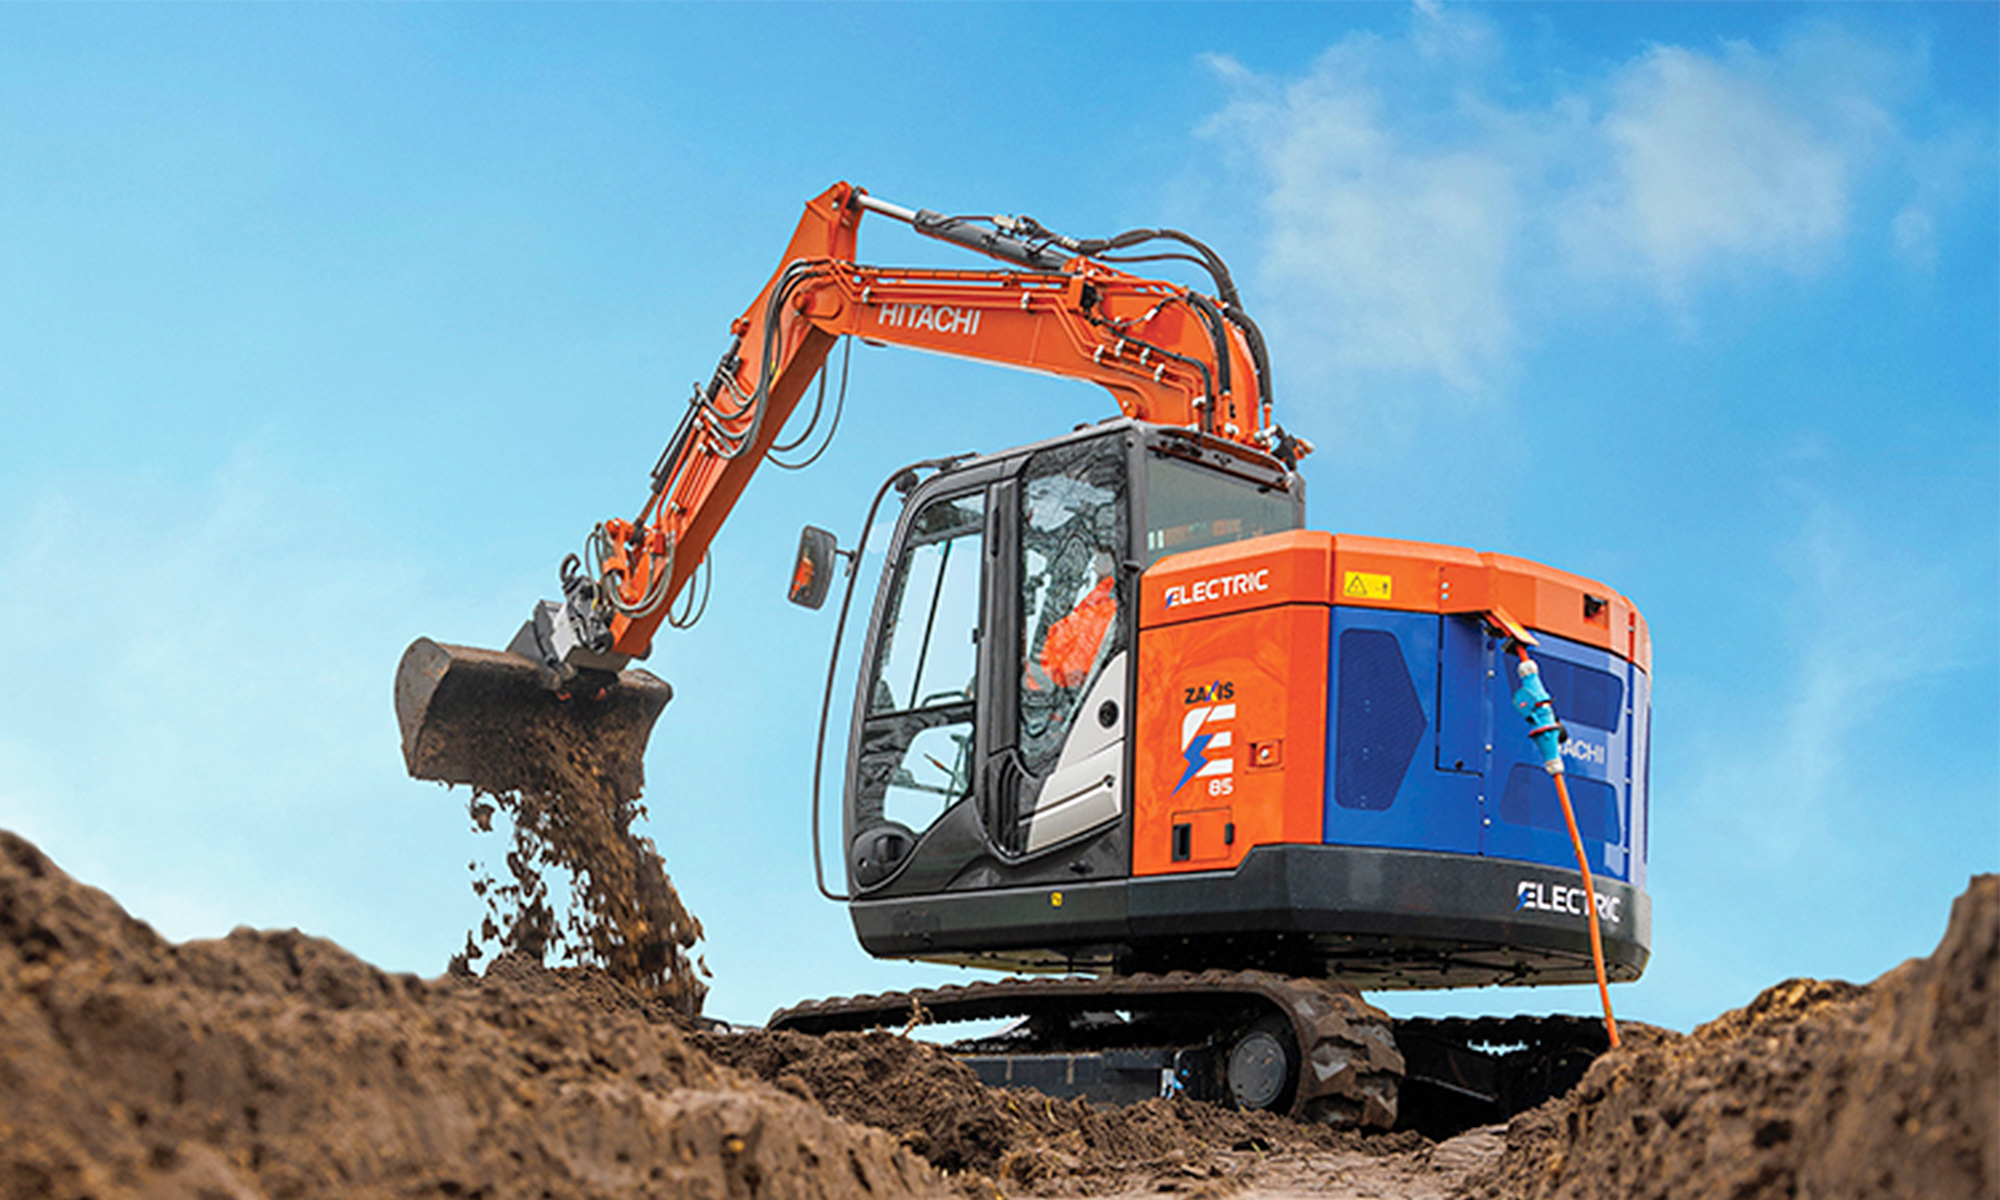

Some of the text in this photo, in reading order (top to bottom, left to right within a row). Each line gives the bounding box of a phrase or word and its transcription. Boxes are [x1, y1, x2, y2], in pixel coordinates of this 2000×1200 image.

[878, 303, 981, 335] HITACHI
[1163, 569, 1269, 611] ELECTRIC
[1184, 680, 1235, 704] ZAXIS
[1558, 738, 1605, 765] ACHI
[1208, 777, 1234, 797] 85
